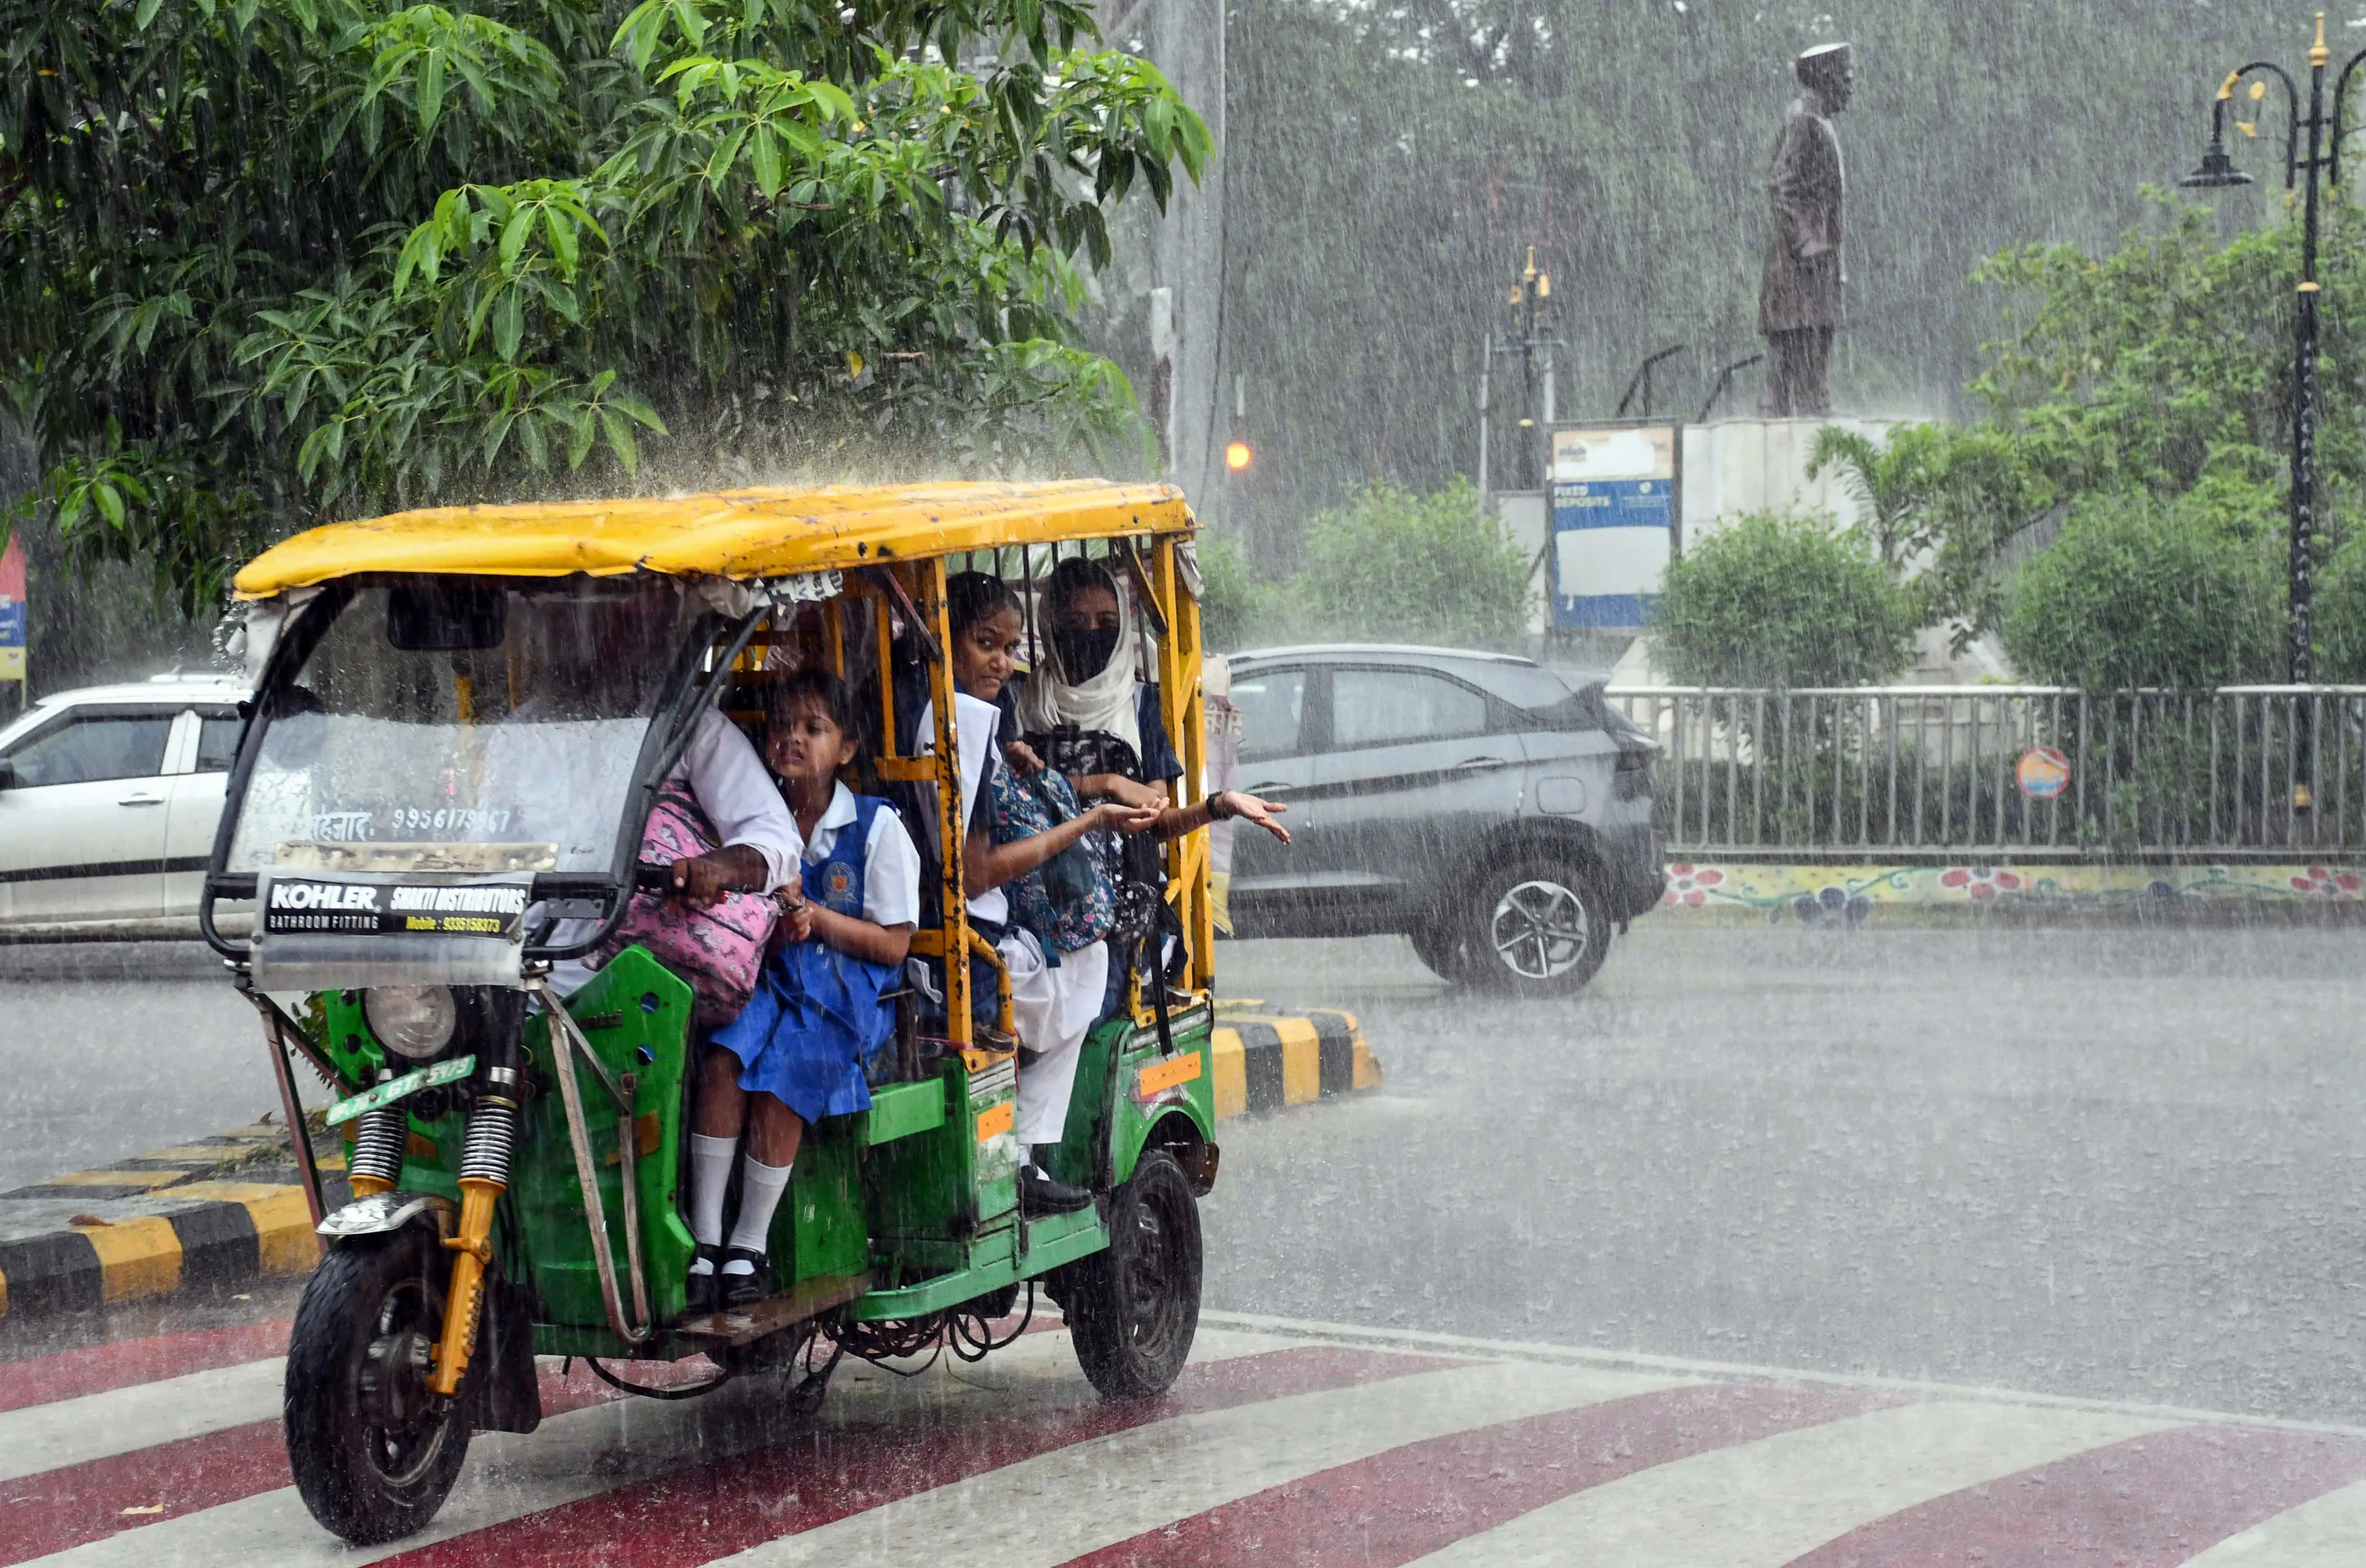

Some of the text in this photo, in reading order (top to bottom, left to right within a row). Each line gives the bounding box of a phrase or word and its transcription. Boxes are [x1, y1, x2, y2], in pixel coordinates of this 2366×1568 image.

[270, 884, 378, 910] KOHLER
[434, 887, 526, 914] DISTRIBUTORS
[269, 915, 379, 930] BATHROOM FITTING
